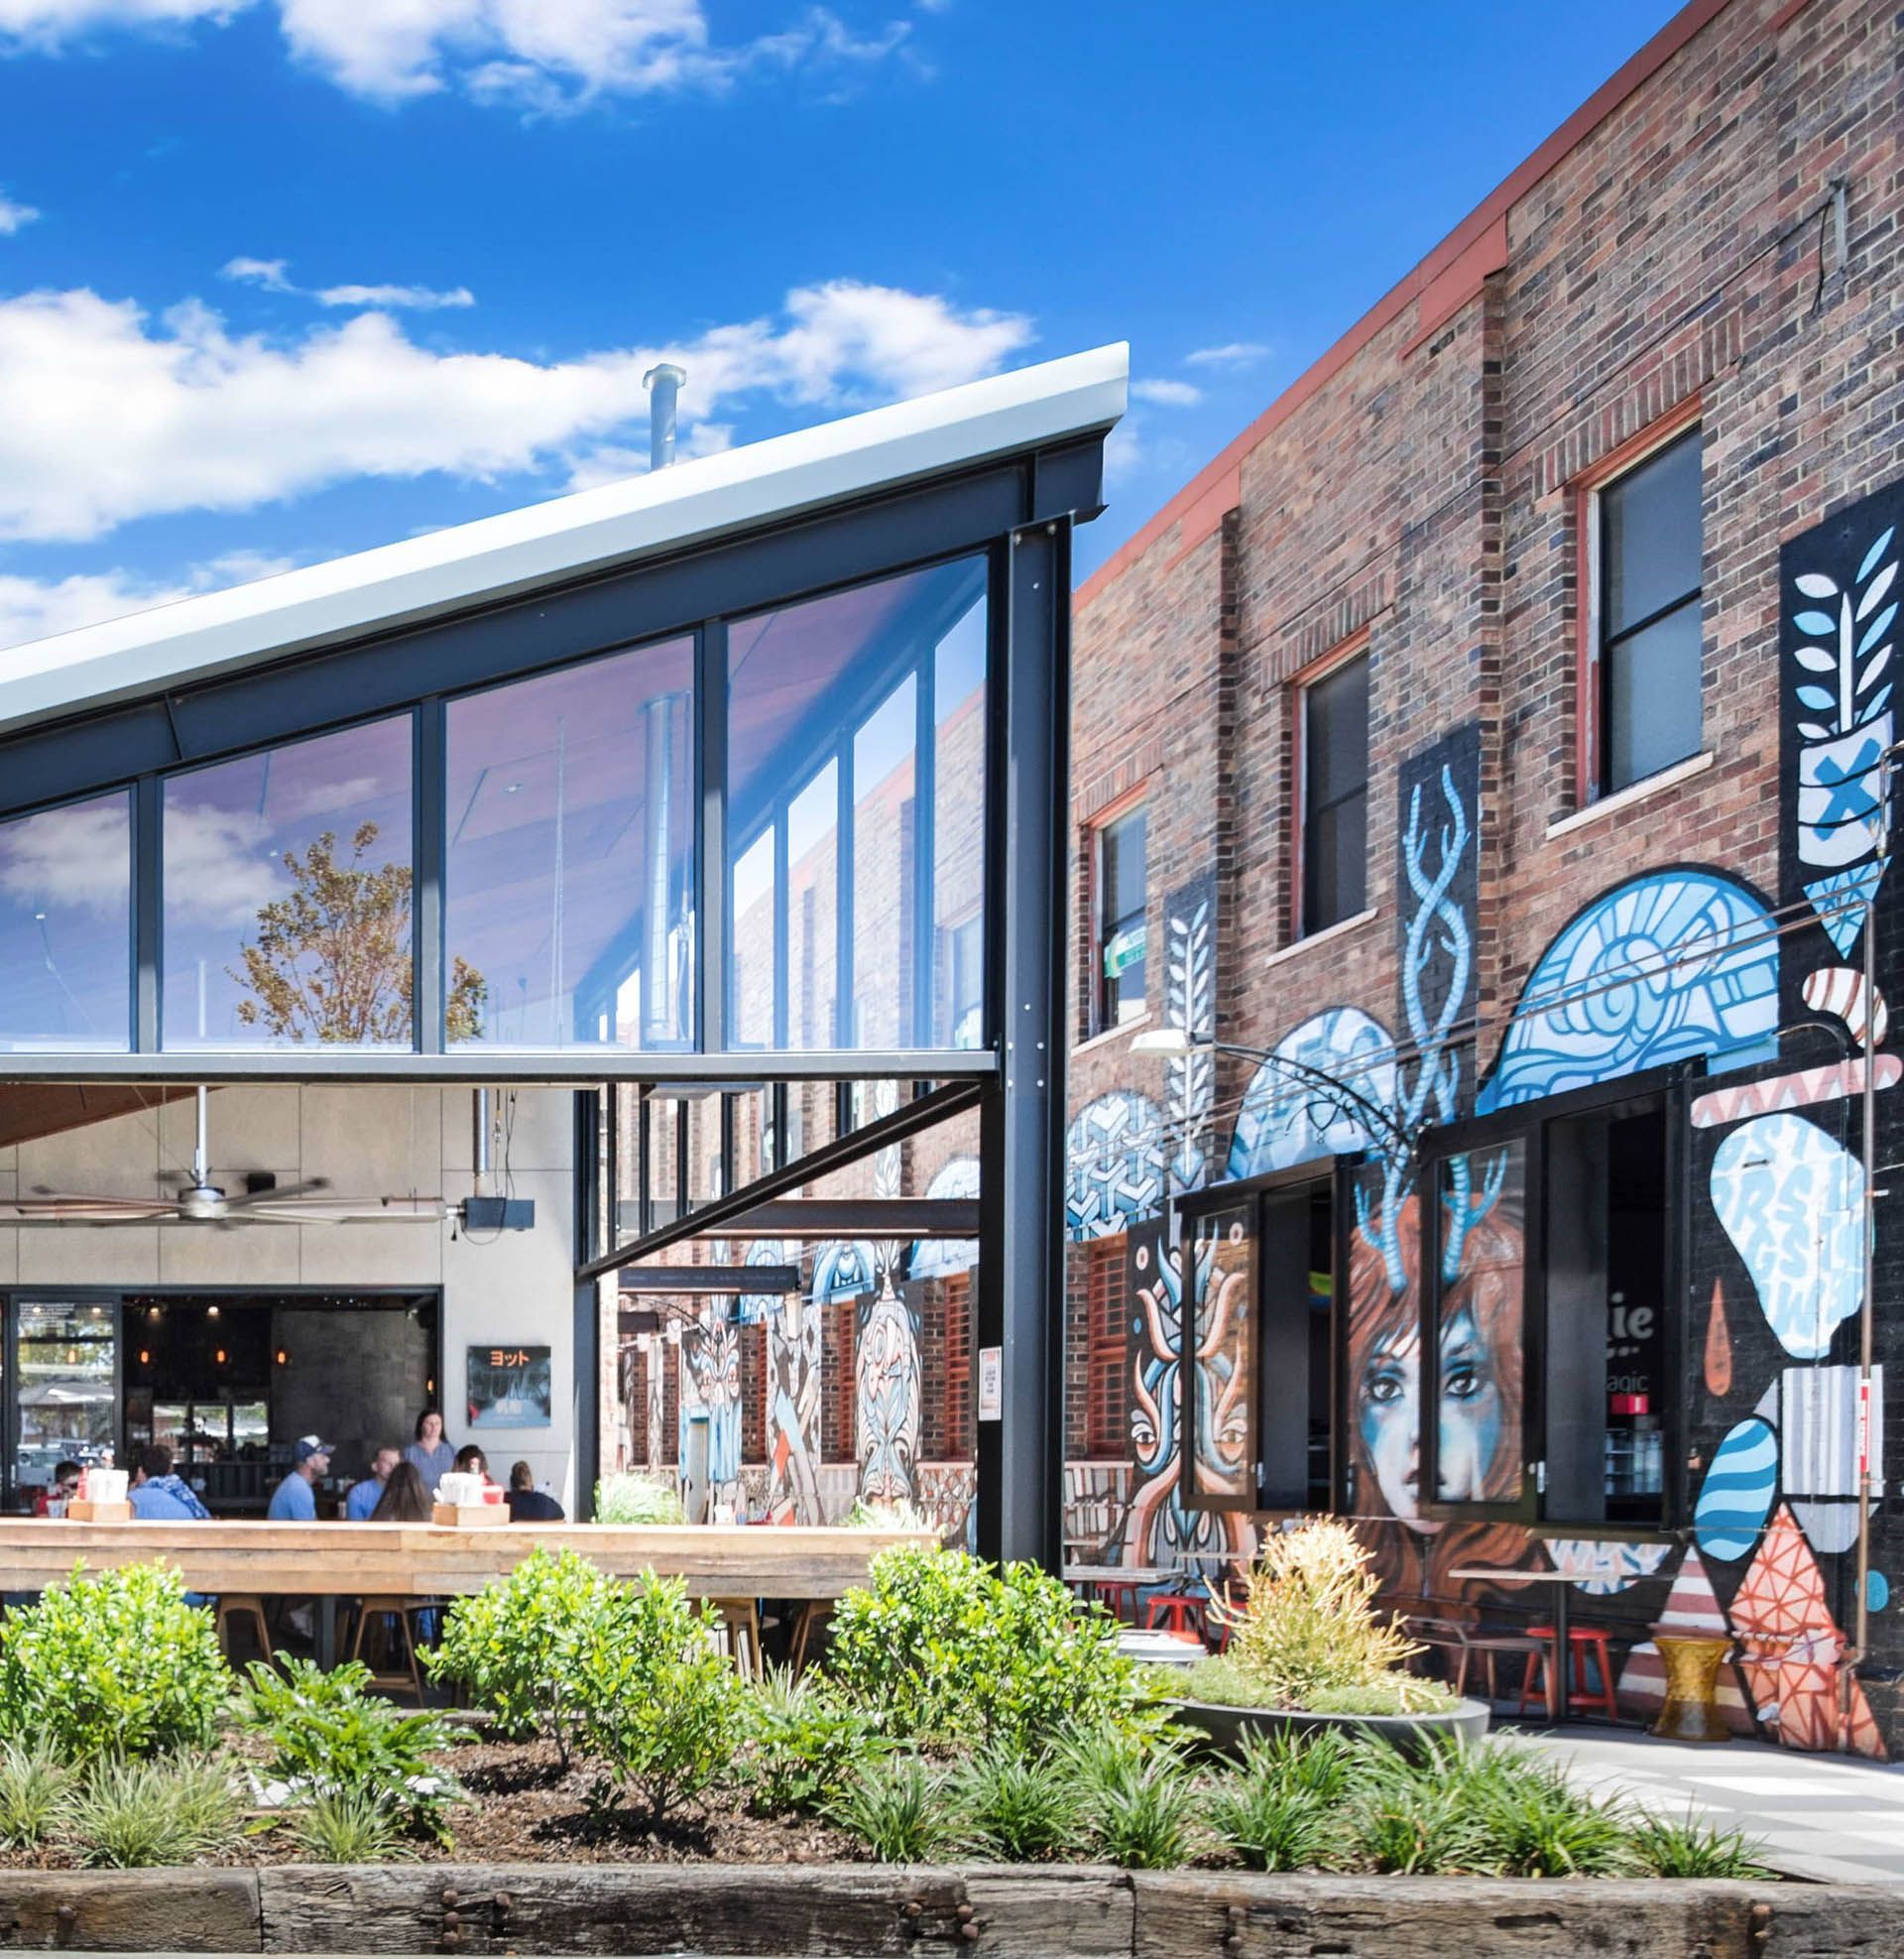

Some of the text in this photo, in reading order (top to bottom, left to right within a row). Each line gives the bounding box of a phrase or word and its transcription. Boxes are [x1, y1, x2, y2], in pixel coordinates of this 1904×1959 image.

[1606, 1291, 1654, 1340] ie
[490, 1349, 530, 1367] ヨット
[1606, 1371, 1649, 1394] agic
